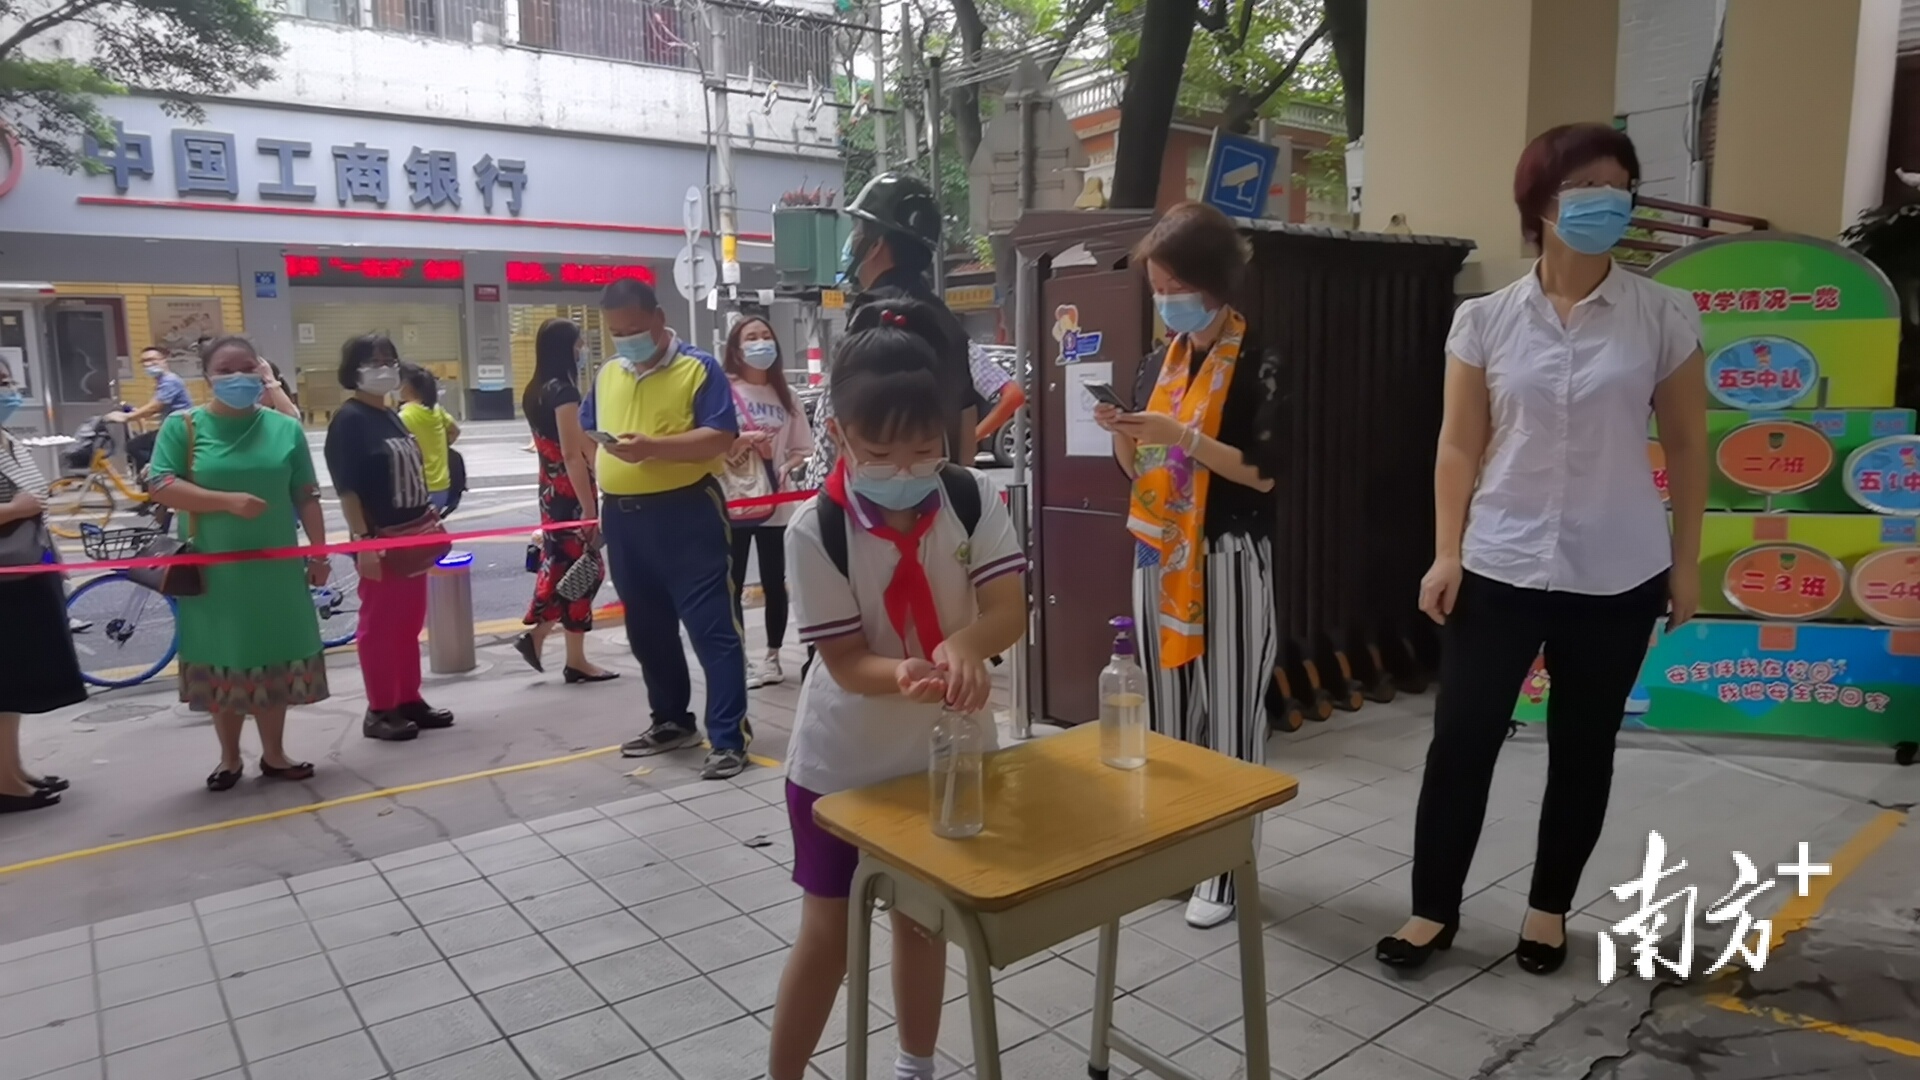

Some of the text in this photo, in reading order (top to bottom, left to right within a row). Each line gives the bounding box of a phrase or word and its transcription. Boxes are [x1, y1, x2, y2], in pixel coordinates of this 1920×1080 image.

[83, 120, 528, 216] 中国工商银行
[1718, 368, 1803, 390] 五5中队
[1743, 456, 1805, 474] 二7班
[1741, 571, 1827, 599] 二3班
[1718, 680, 1891, 713] 我把安全带回家
